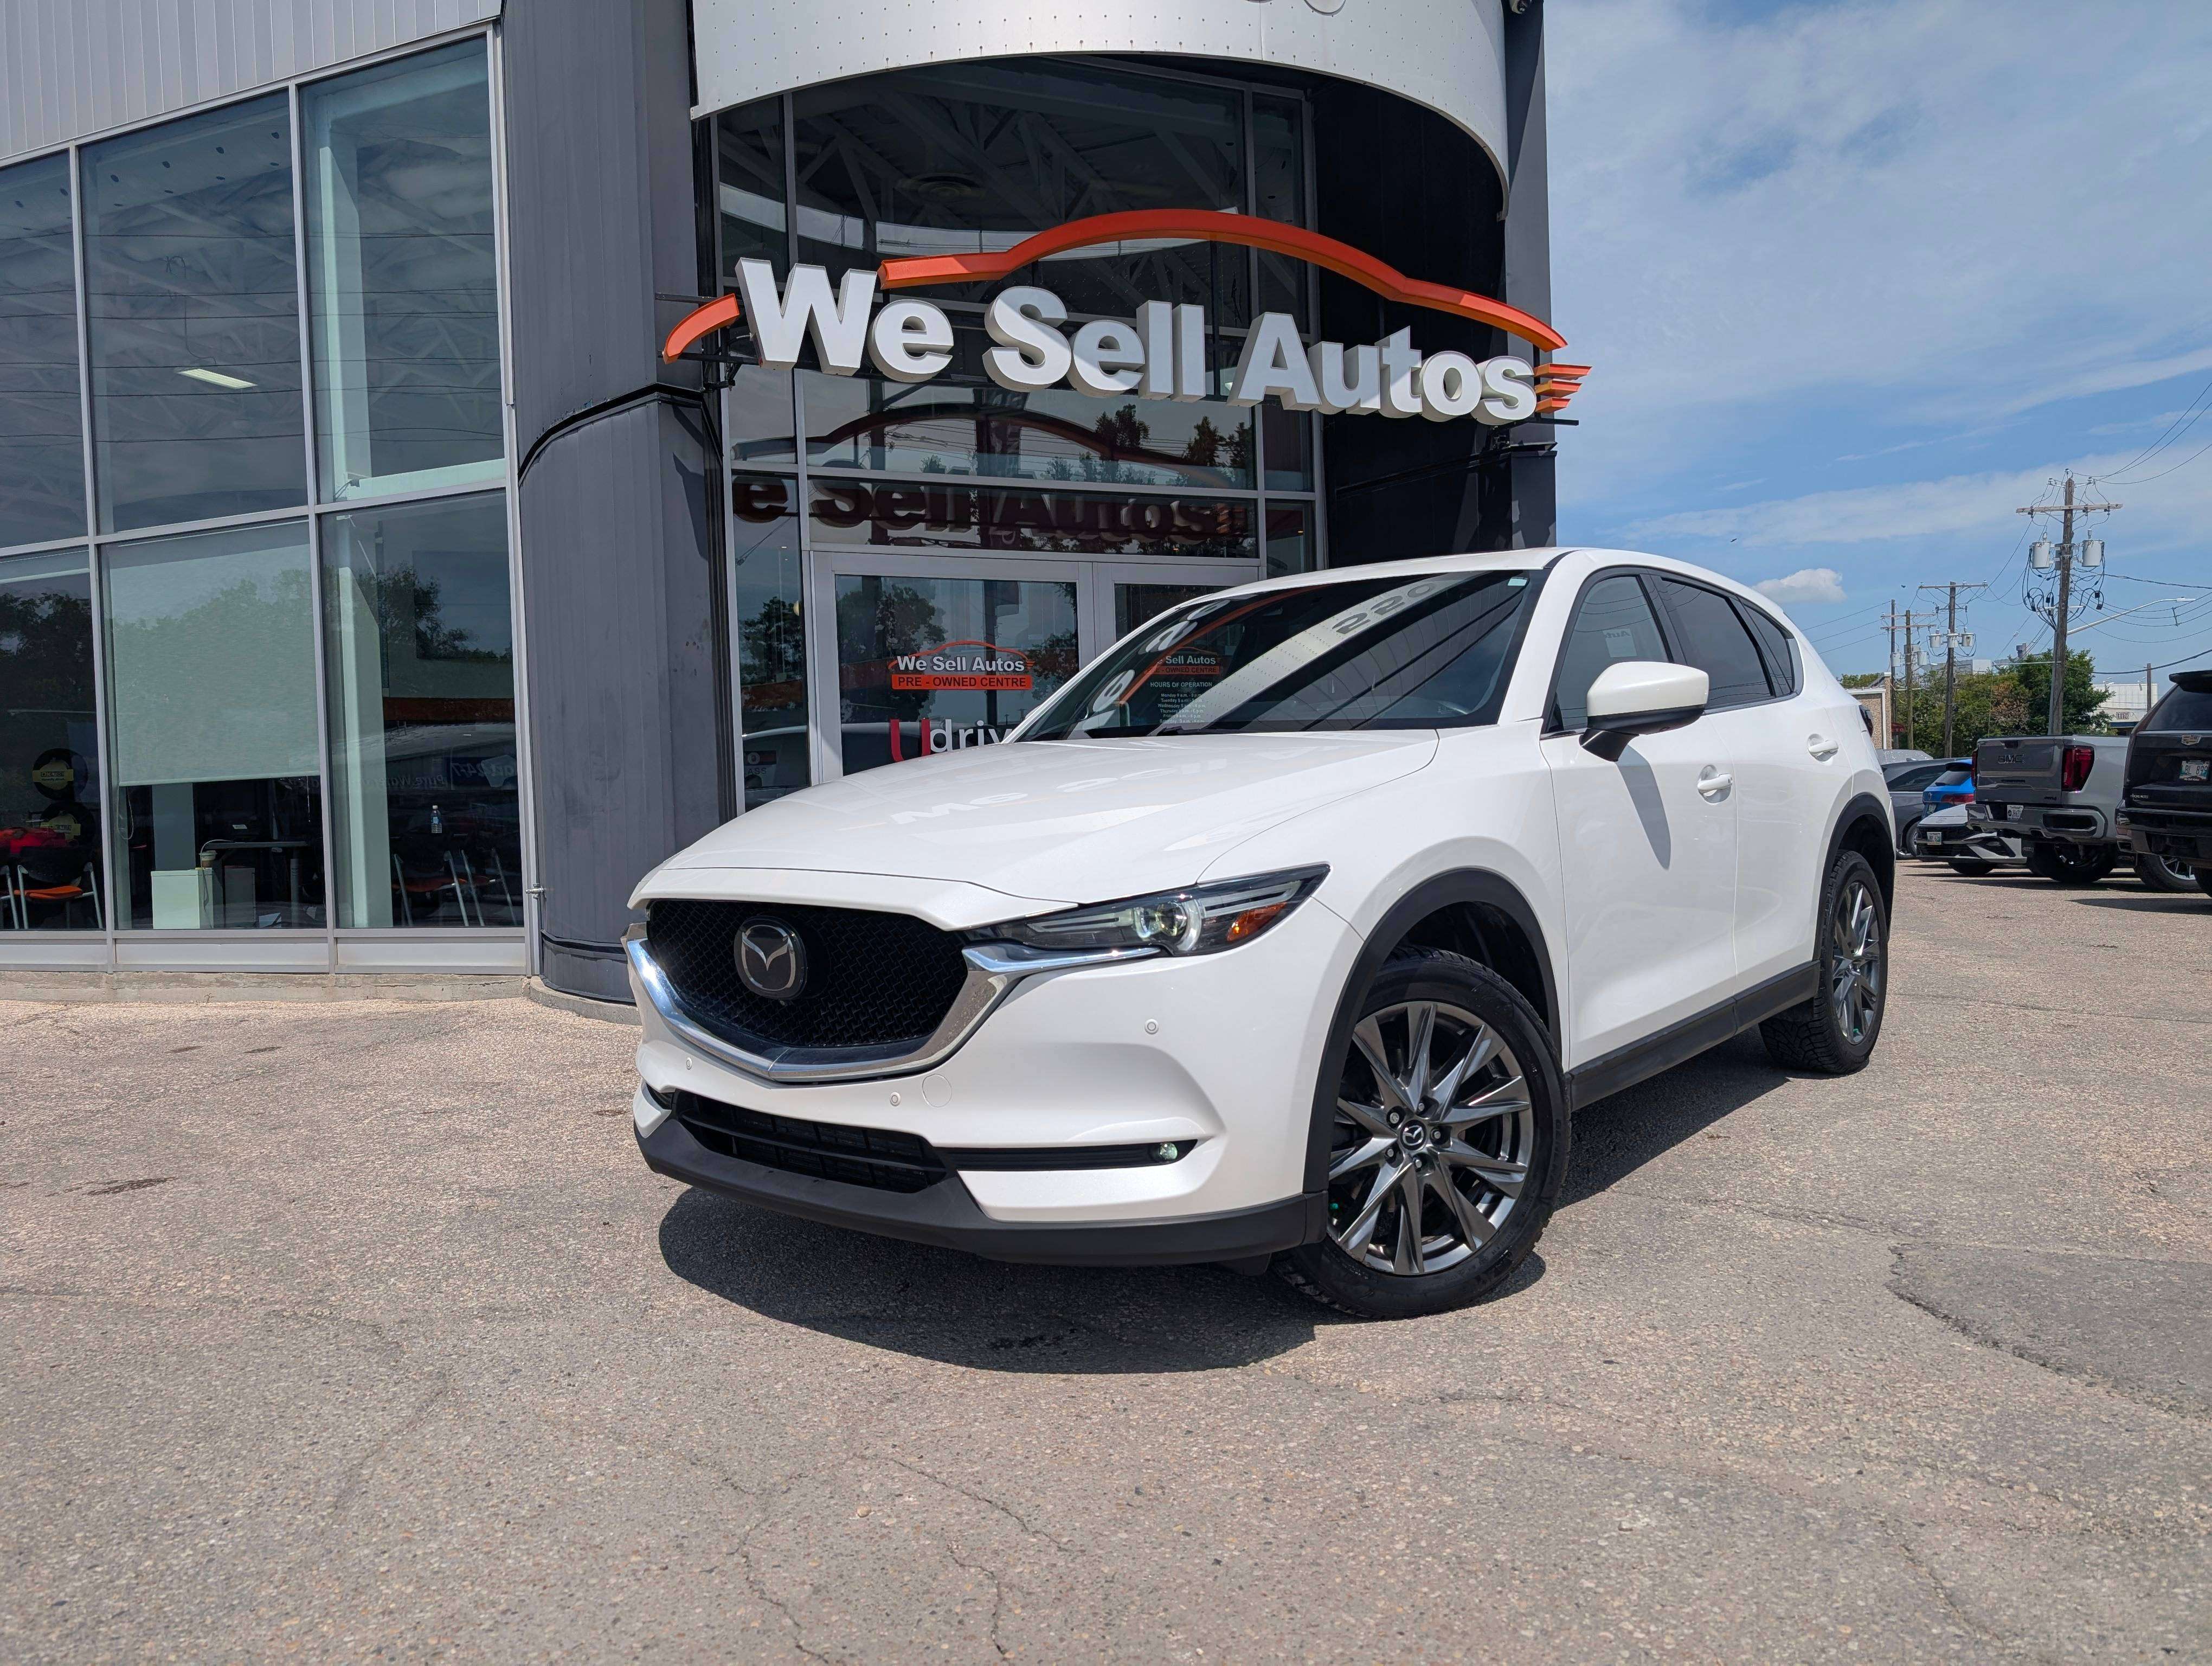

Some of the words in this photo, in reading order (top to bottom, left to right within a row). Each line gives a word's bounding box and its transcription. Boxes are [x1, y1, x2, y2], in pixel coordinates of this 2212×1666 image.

[735, 257, 954, 383] We
[983, 285, 1205, 402] Sell
[1225, 311, 1538, 426] Autos
[897, 656, 927, 670] We
[933, 656, 966, 671] Sell
[972, 657, 1025, 671] Autos
[1166, 655, 1184, 664] Sell
[1187, 655, 1216, 664] Autos
[898, 677, 922, 687] PRE
[933, 676, 977, 687] OWNED
[980, 677, 1026, 687] CENTRE
